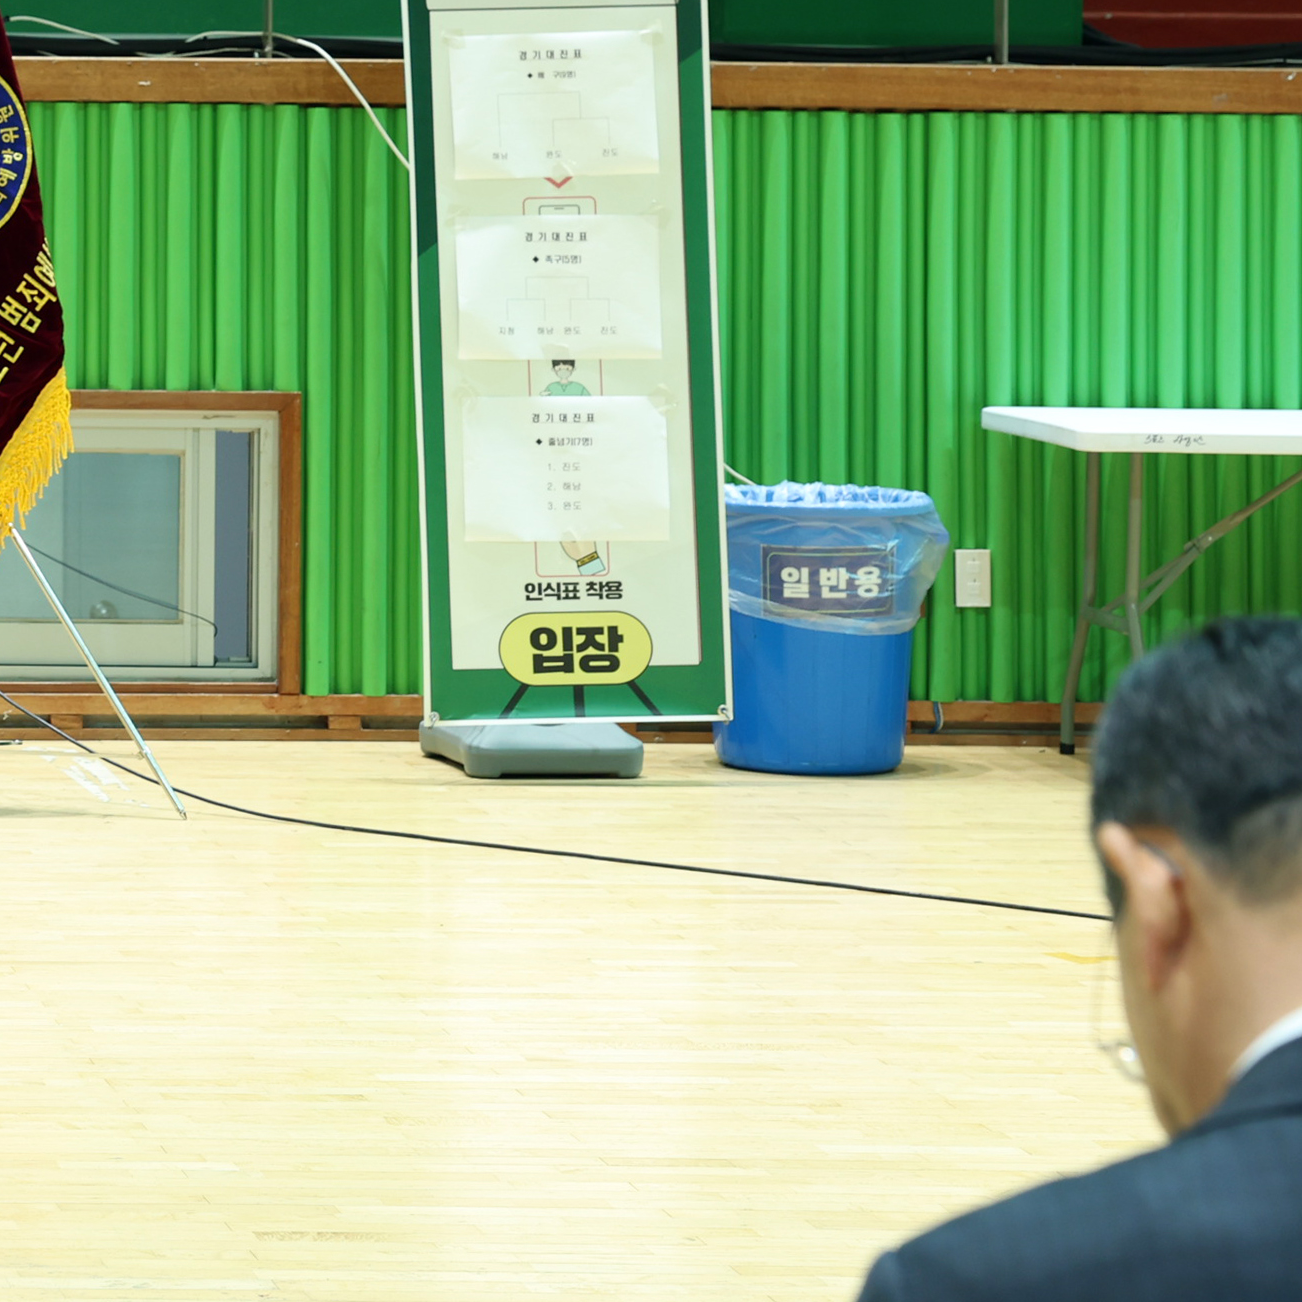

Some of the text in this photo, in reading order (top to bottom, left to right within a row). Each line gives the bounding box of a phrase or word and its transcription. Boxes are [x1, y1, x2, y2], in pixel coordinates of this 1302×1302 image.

[524, 581, 623, 601] 인식표 착용
[529, 625, 624, 674] 입장
